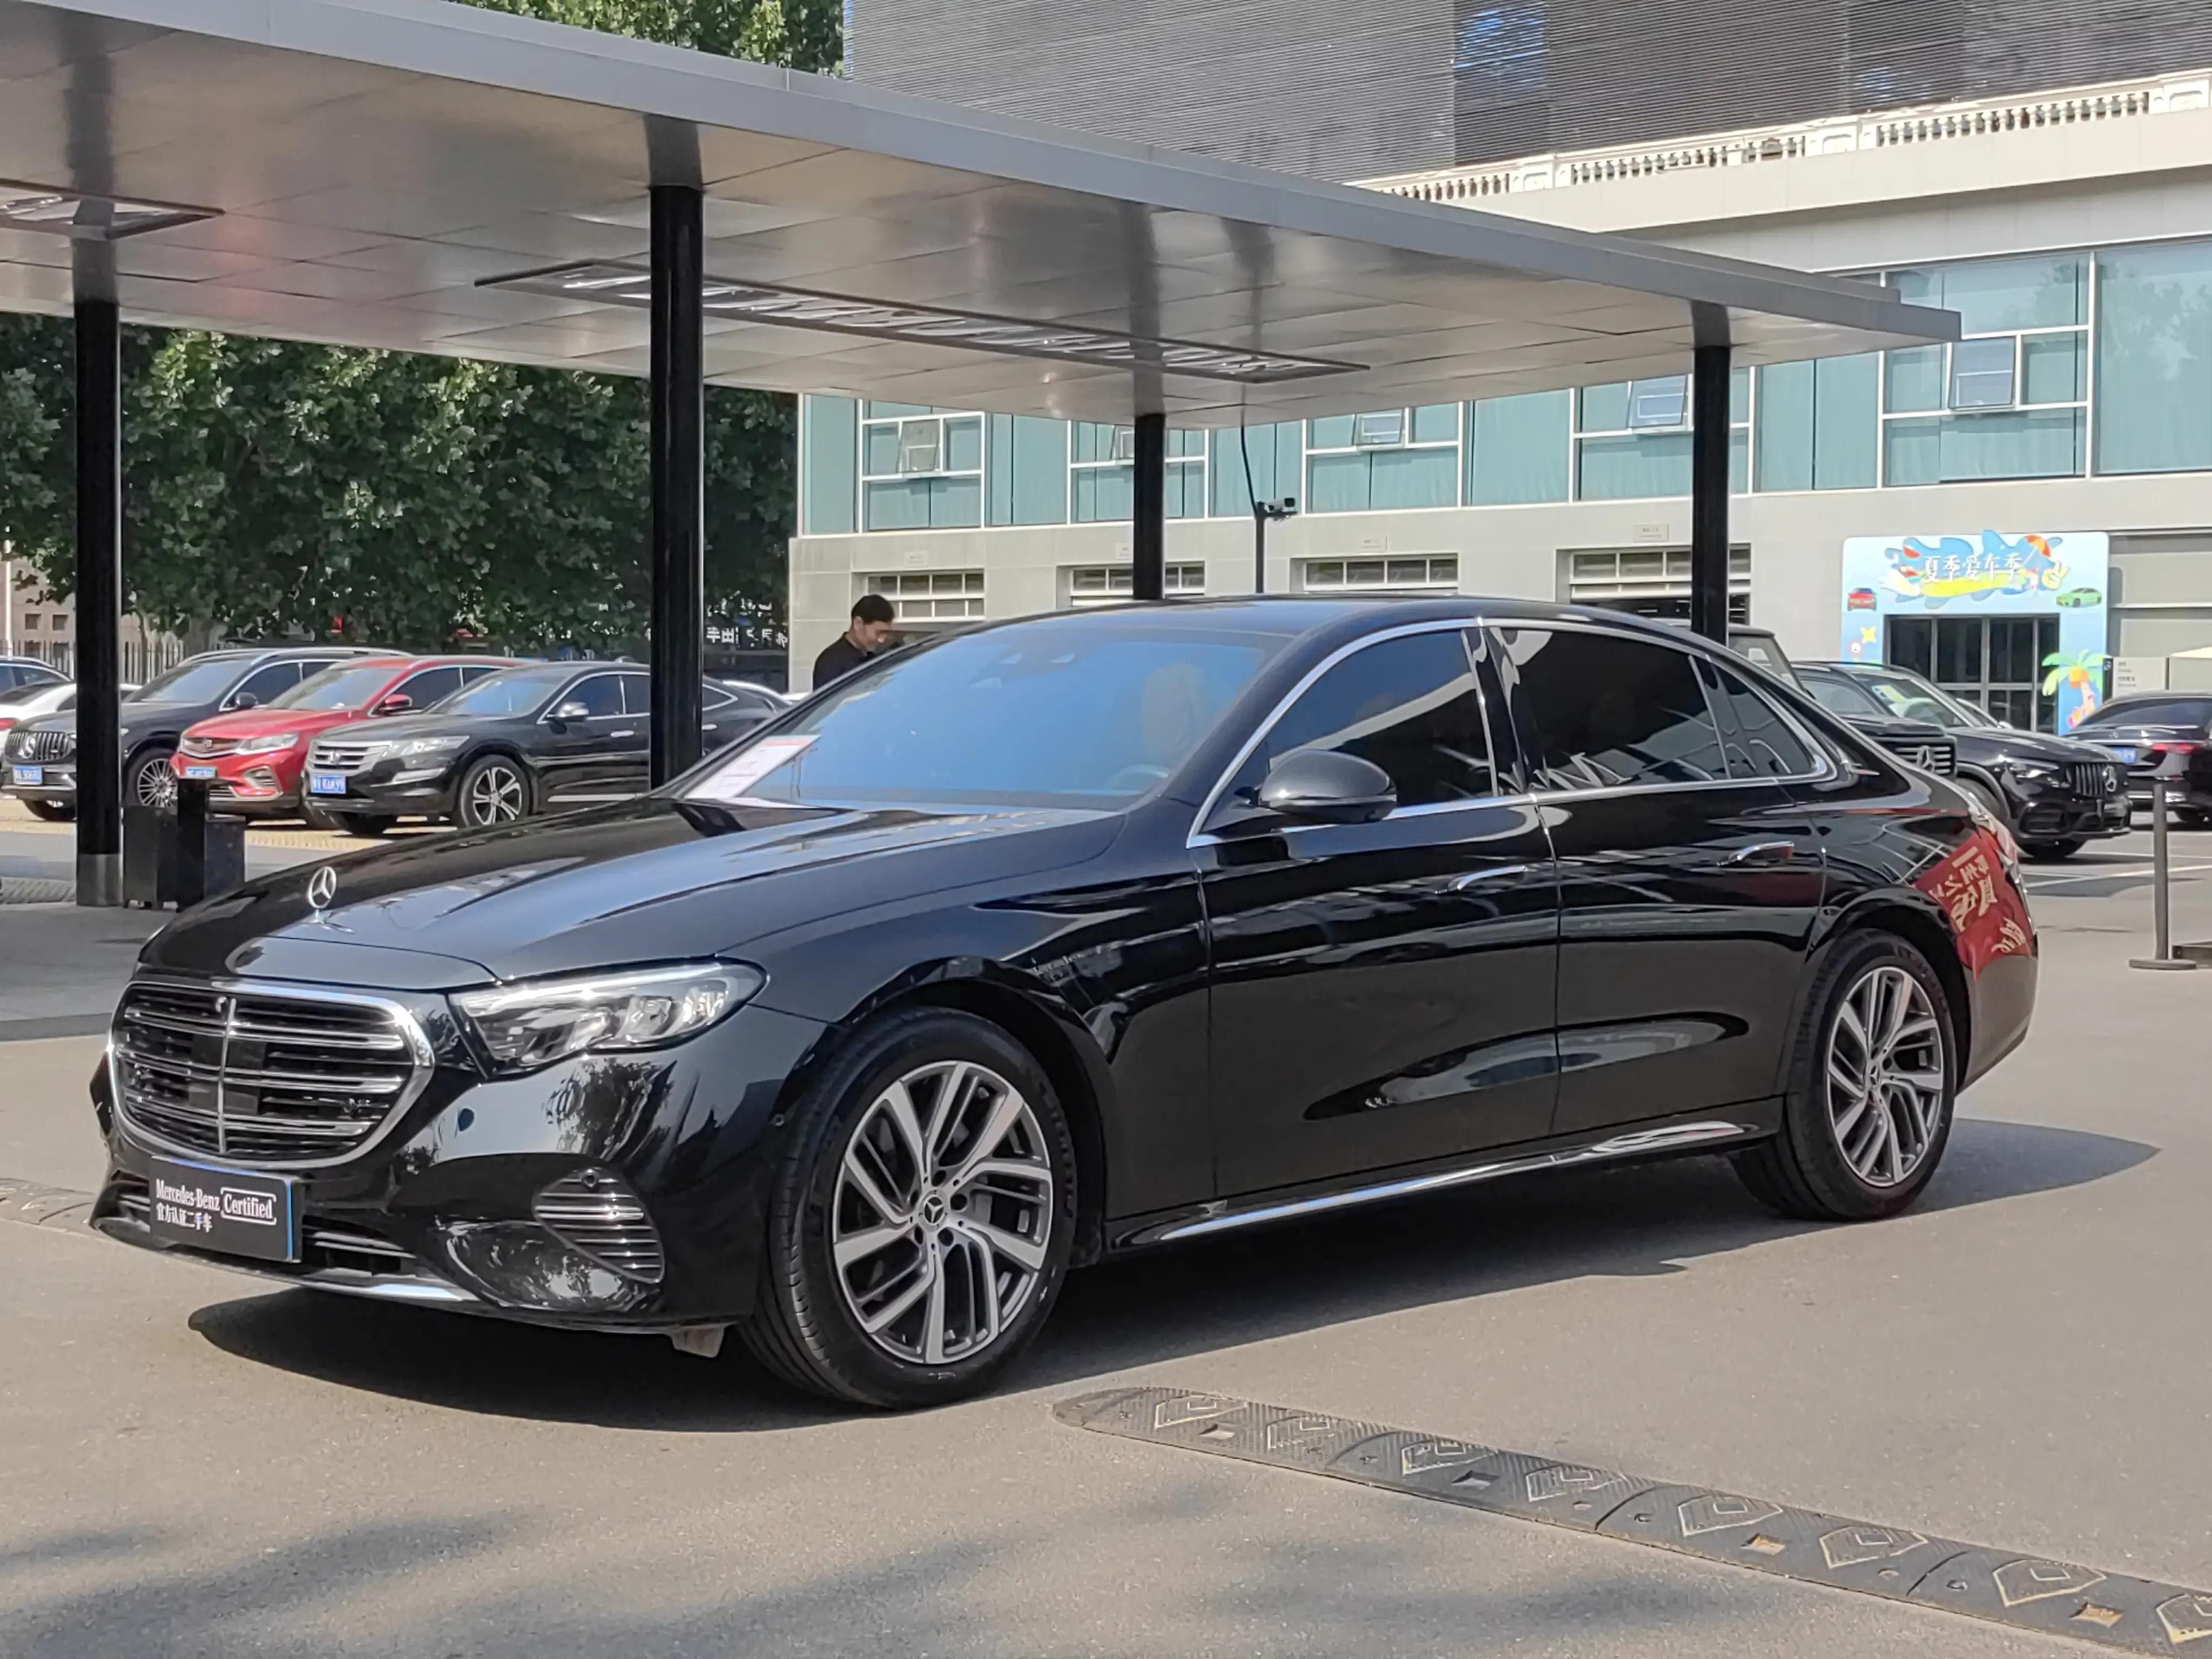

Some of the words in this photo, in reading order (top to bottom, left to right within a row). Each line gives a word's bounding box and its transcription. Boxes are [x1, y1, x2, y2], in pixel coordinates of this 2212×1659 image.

[1924, 552, 2022, 583] 夏季爱车季
[224, 1193, 273, 1219] Certified
